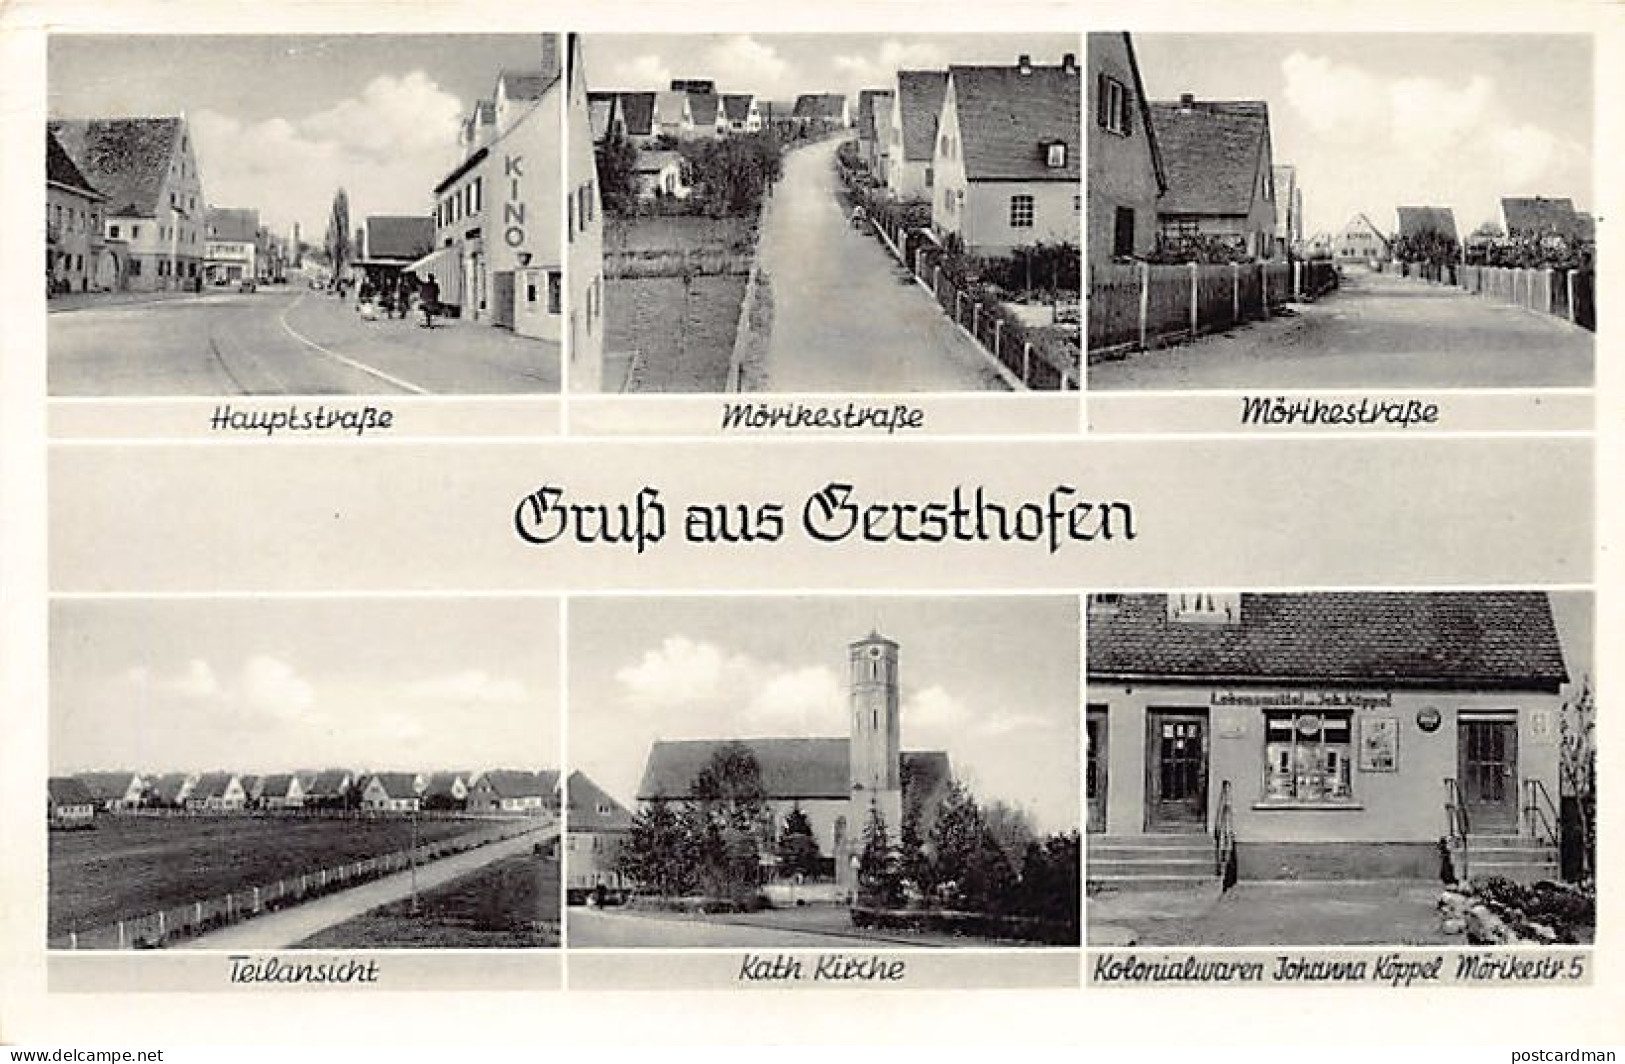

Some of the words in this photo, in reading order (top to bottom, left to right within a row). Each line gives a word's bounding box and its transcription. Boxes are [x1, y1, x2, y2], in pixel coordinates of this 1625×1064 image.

[504, 155, 525, 248] KINO
[210, 403, 394, 436] Hauptstraße
[722, 403, 924, 433] Mörikestraße
[1241, 396, 1438, 429] Mörikestraße
[514, 486, 667, 554] Gruß
[685, 503, 784, 542] aus
[802, 482, 1137, 554] Gersthofen
[228, 956, 380, 983] Teilansicht
[813, 954, 906, 981] Kirche
[1093, 954, 1264, 982] Kolonialwaren
[1273, 956, 1367, 982] Johanna
[1372, 953, 1444, 988] Köppel
